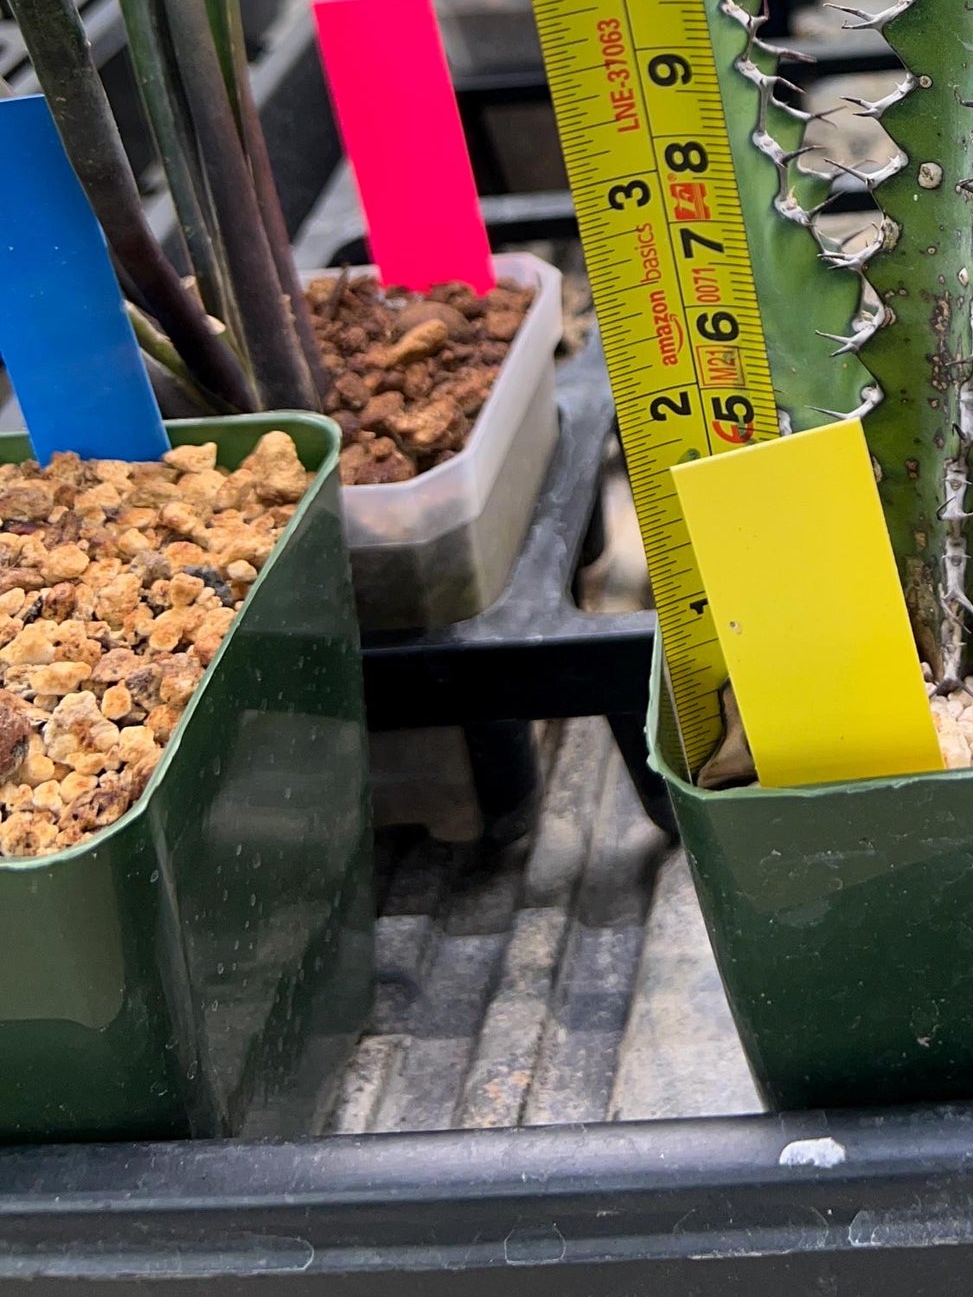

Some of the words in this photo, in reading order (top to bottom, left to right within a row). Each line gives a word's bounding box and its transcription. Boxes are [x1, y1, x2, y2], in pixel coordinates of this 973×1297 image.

[597, 18, 640, 132] LNE-37063
[649, 55, 691, 86] 9
[665, 142, 707, 172] 8
[609, 181, 649, 209] 3
[637, 224, 662, 284] basics
[681, 229, 723, 258] 7
[692, 268, 720, 304] 0071
[648, 290, 678, 366] amazon
[697, 312, 738, 341] 6
[705, 349, 737, 383] M21
[651, 392, 691, 420] 2
[712, 396, 753, 423] 5
